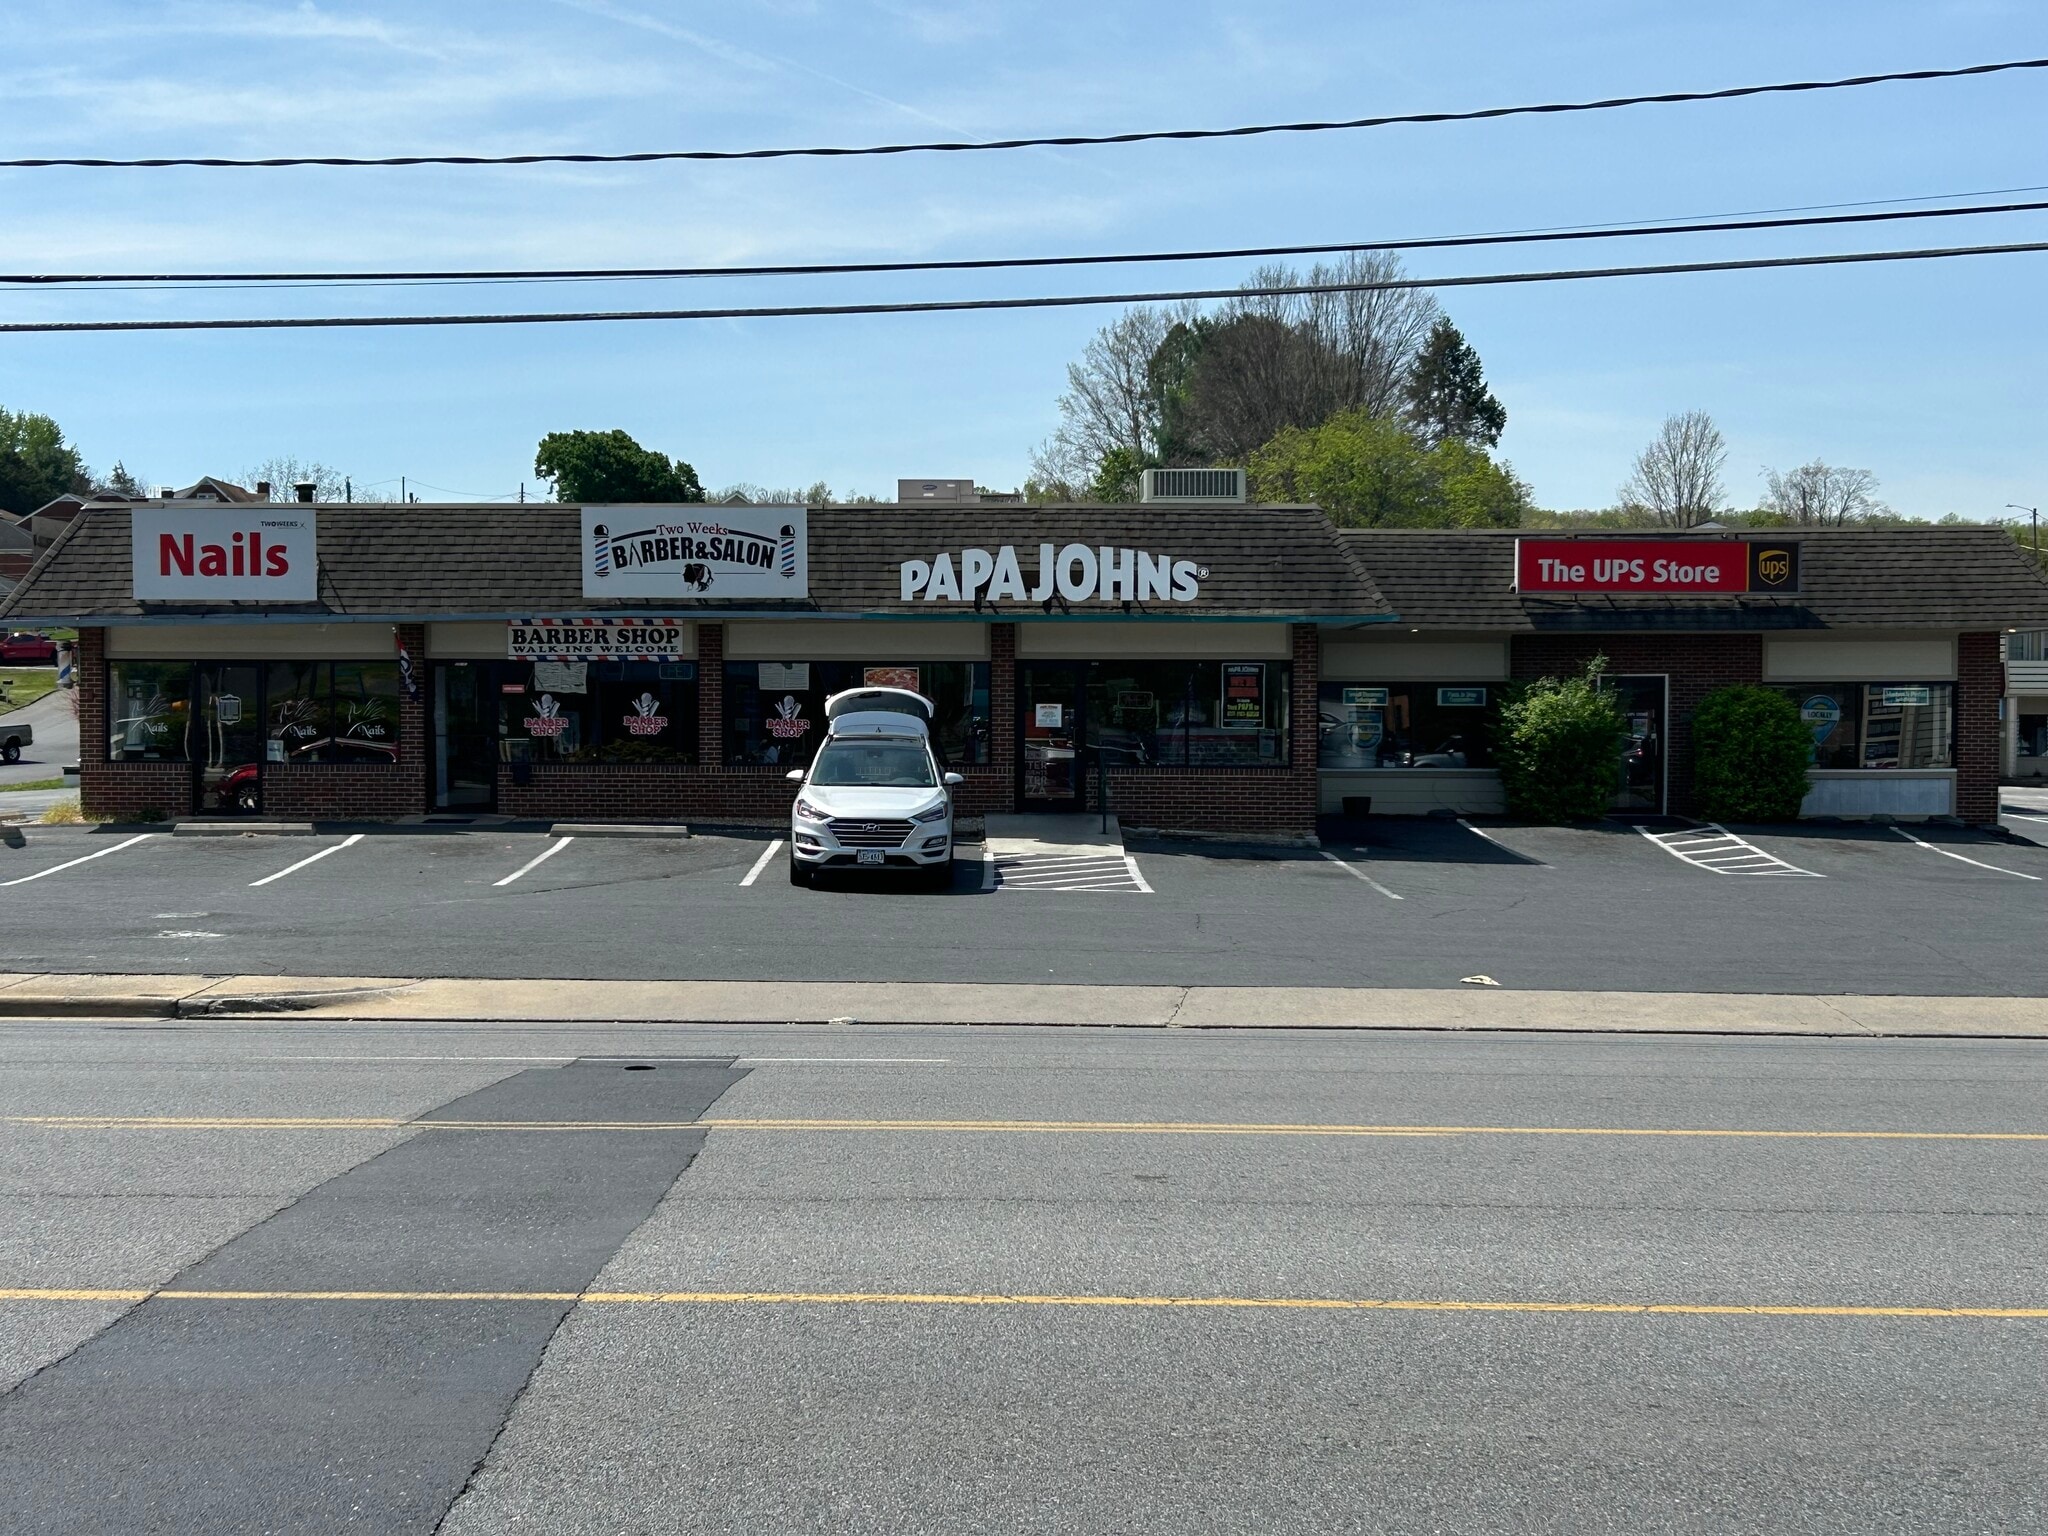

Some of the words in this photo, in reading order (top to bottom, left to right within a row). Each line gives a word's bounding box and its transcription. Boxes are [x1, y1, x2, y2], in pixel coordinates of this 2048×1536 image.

[656, 524, 684, 536] Two
[687, 522, 729, 536] Weeks
[160, 531, 289, 577] Nails
[900, 545, 1028, 601] PAPA
[1538, 559, 1585, 583] The
[1593, 559, 1645, 583] UPS
[1652, 559, 1720, 583] Store
[1761, 559, 1786, 578] ups
[512, 628, 609, 645] BARBER
[617, 628, 680, 645] SHOP
[513, 645, 593, 653] WALK-INS
[600, 645, 679, 653] WELCOME
[524, 718, 569, 728] BARBER
[623, 716, 668, 726] BARBER
[766, 719, 810, 729] BARBER
[143, 722, 168, 735] Nails
[289, 725, 317, 738] Nails
[358, 725, 386, 738] Nails
[531, 727, 562, 736] SHOP
[630, 725, 661, 735] SHOP
[773, 728, 803, 737] SHOP
